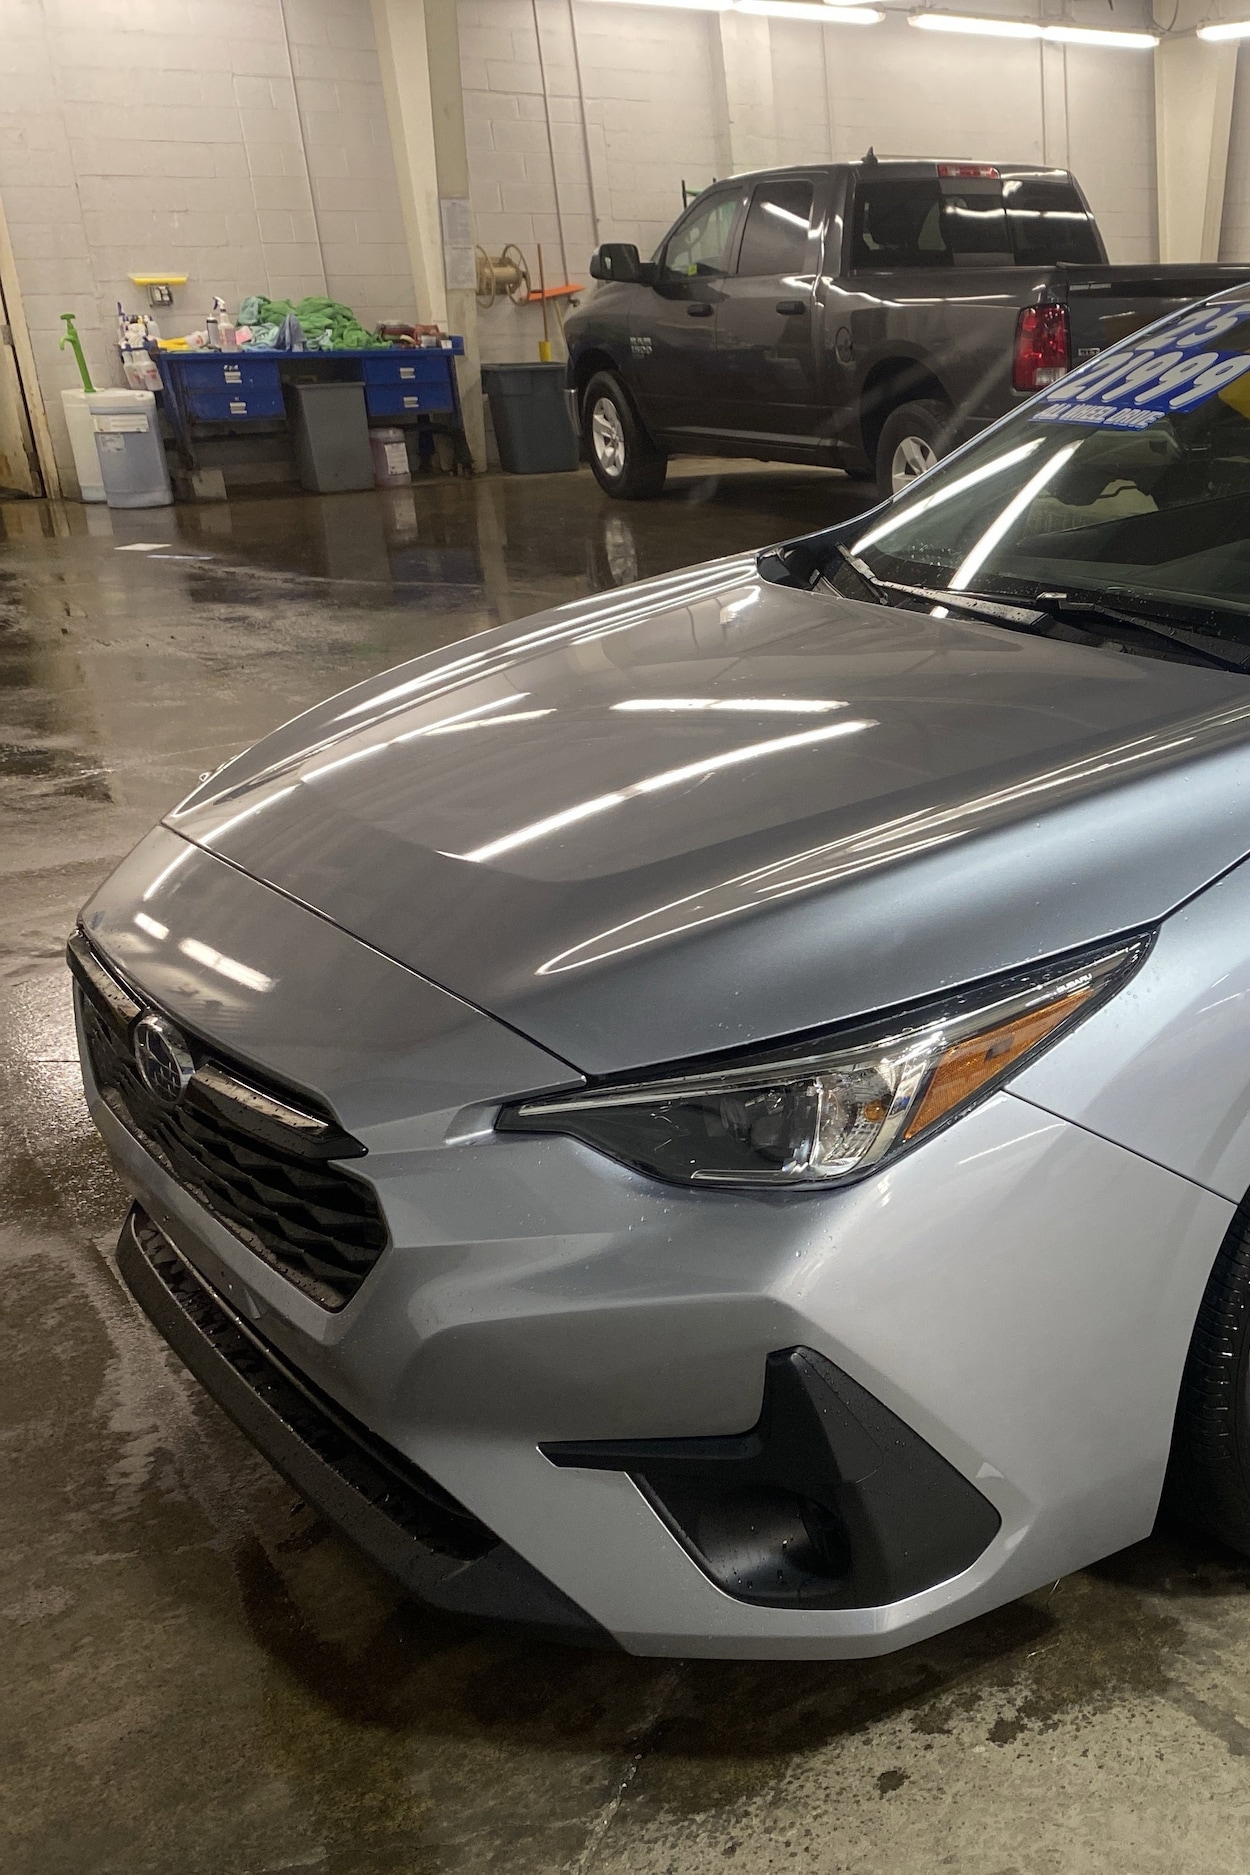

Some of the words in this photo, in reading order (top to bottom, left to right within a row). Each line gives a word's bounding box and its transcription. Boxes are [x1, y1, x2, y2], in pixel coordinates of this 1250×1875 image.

[1033, 403, 1072, 420] ALL
[1059, 403, 1117, 423] WHEEL
[1103, 407, 1166, 429] DRIVE
